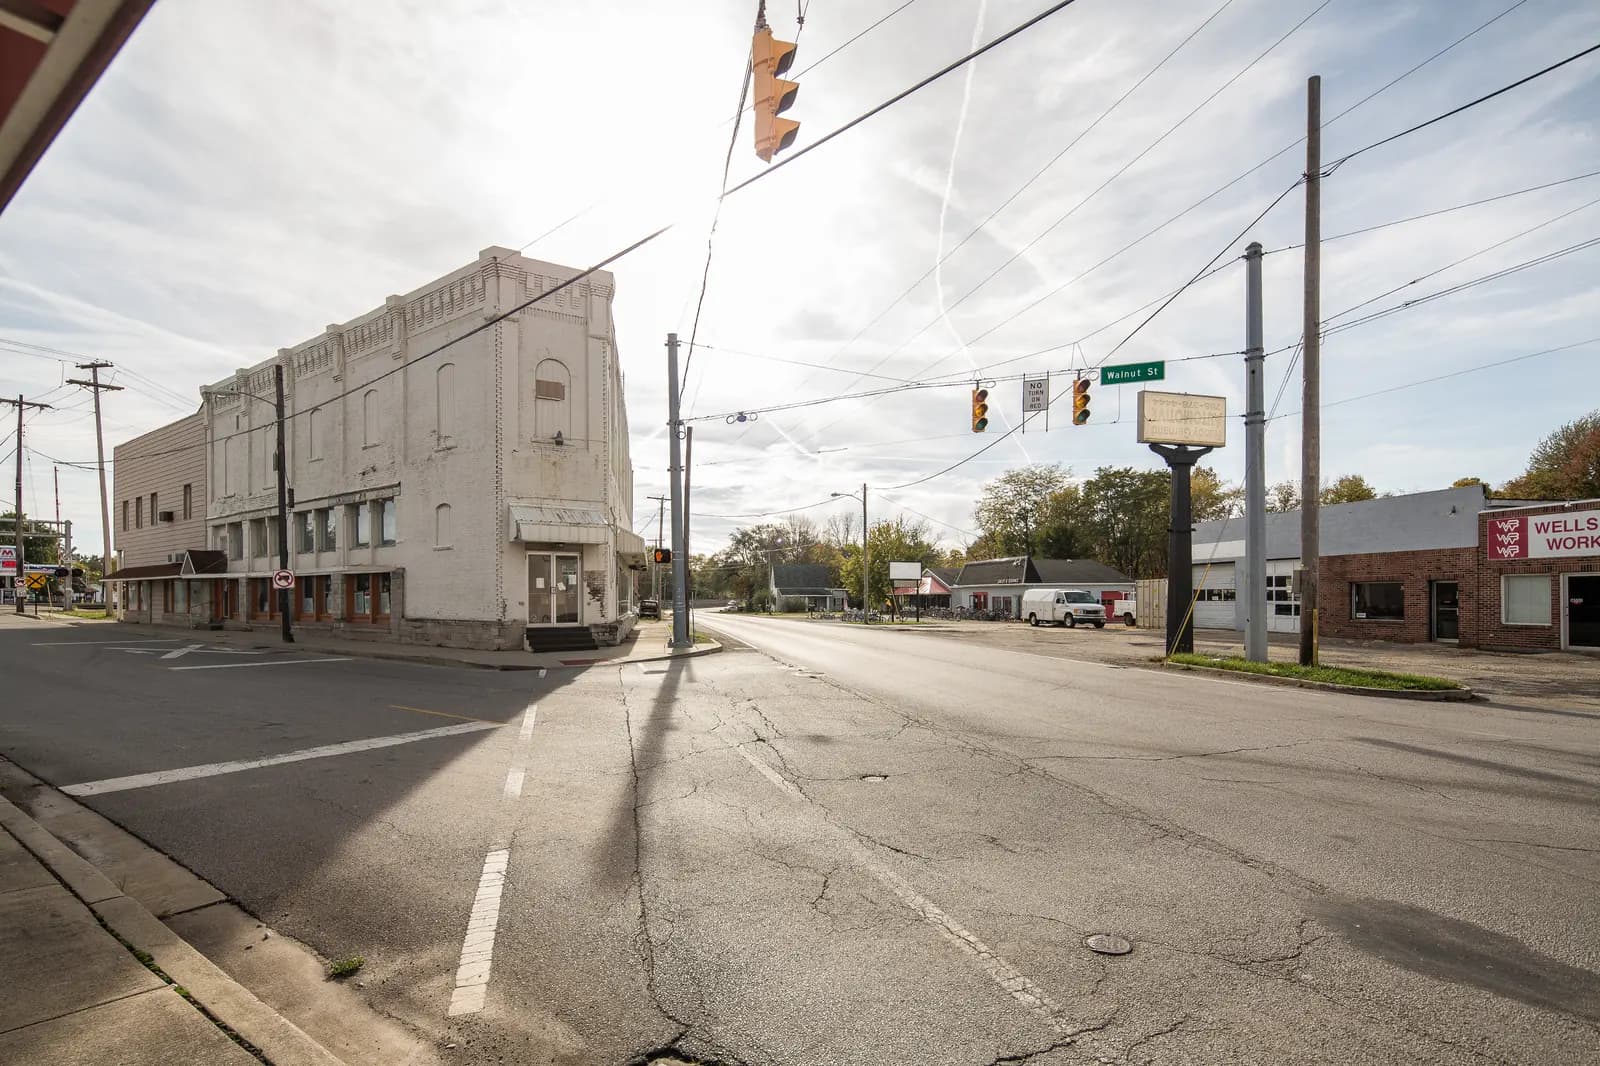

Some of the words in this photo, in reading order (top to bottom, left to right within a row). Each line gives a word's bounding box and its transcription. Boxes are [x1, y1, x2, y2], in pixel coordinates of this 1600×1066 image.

[1107, 369, 1141, 379] Walnut
[1147, 367, 1158, 376] St
[1030, 382, 1042, 390] NO
[1534, 517, 1599, 535] WELLS
[1546, 535, 1600, 551] WORK
